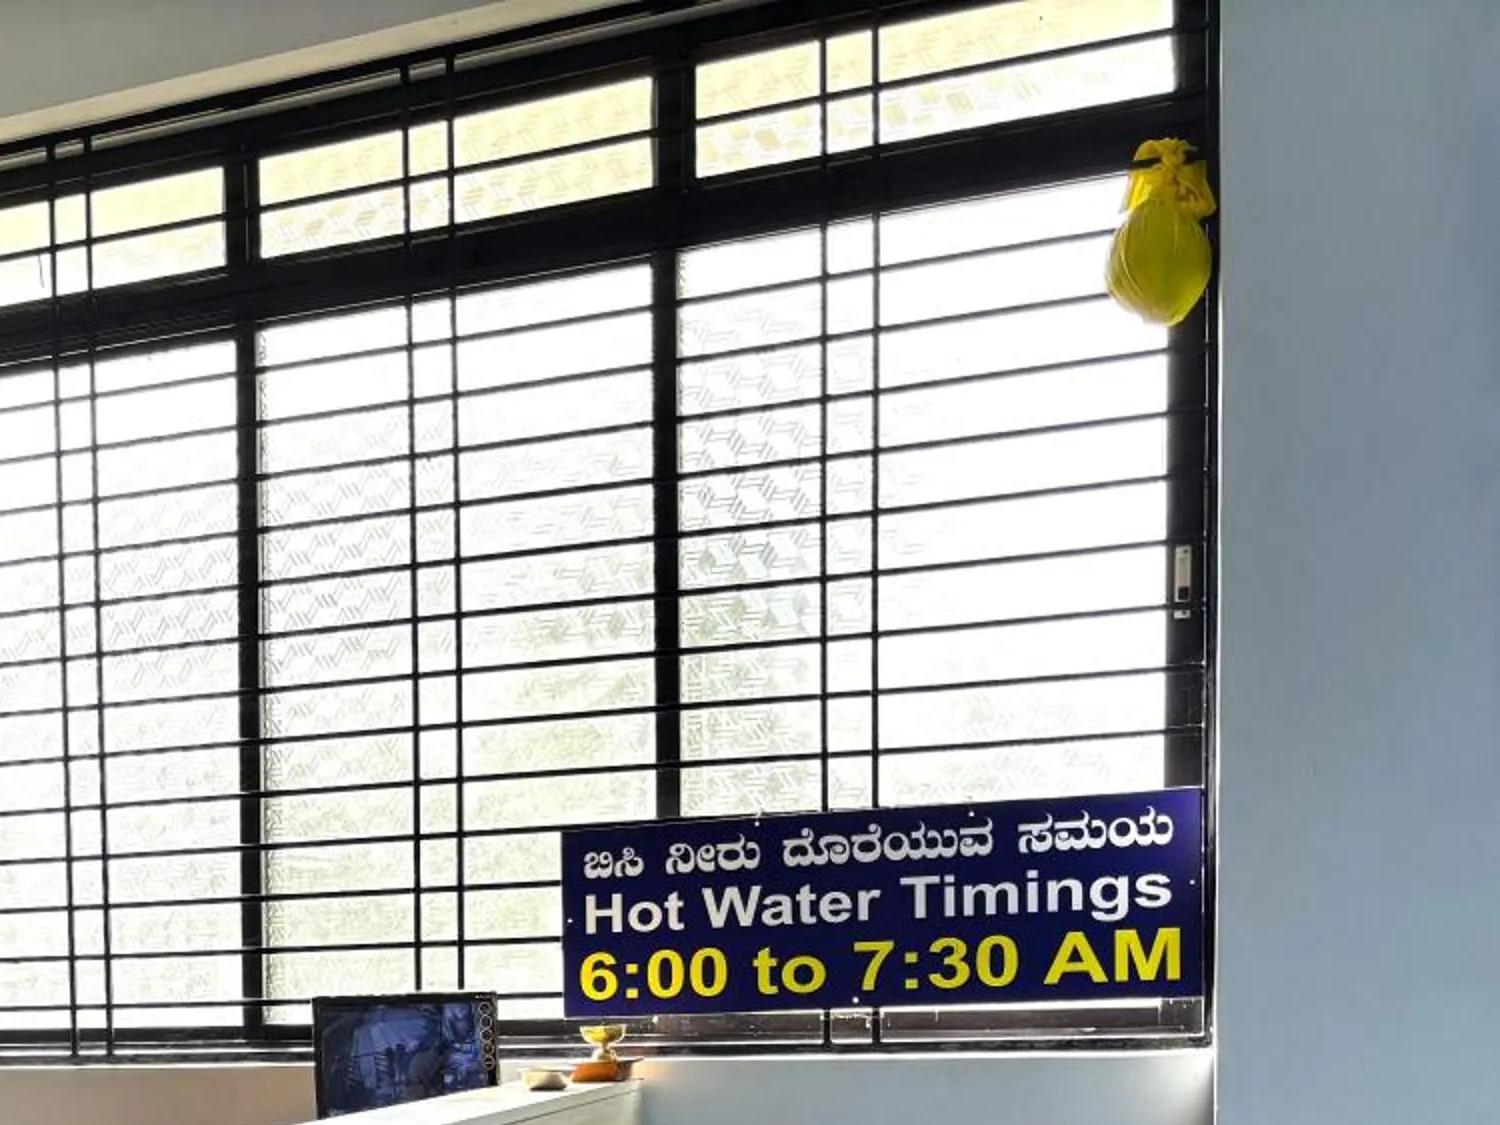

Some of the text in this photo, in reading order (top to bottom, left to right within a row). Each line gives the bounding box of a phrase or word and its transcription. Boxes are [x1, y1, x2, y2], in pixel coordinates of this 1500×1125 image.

[582, 846, 645, 879] ಬಿಸಿ
[664, 833, 762, 875] ನೀರು
[1017, 804, 1175, 853] ಸಮಯ
[584, 868, 1174, 935] Hot Water Timings
[579, 927, 1182, 1001] 6:00 to 7:30 AM
